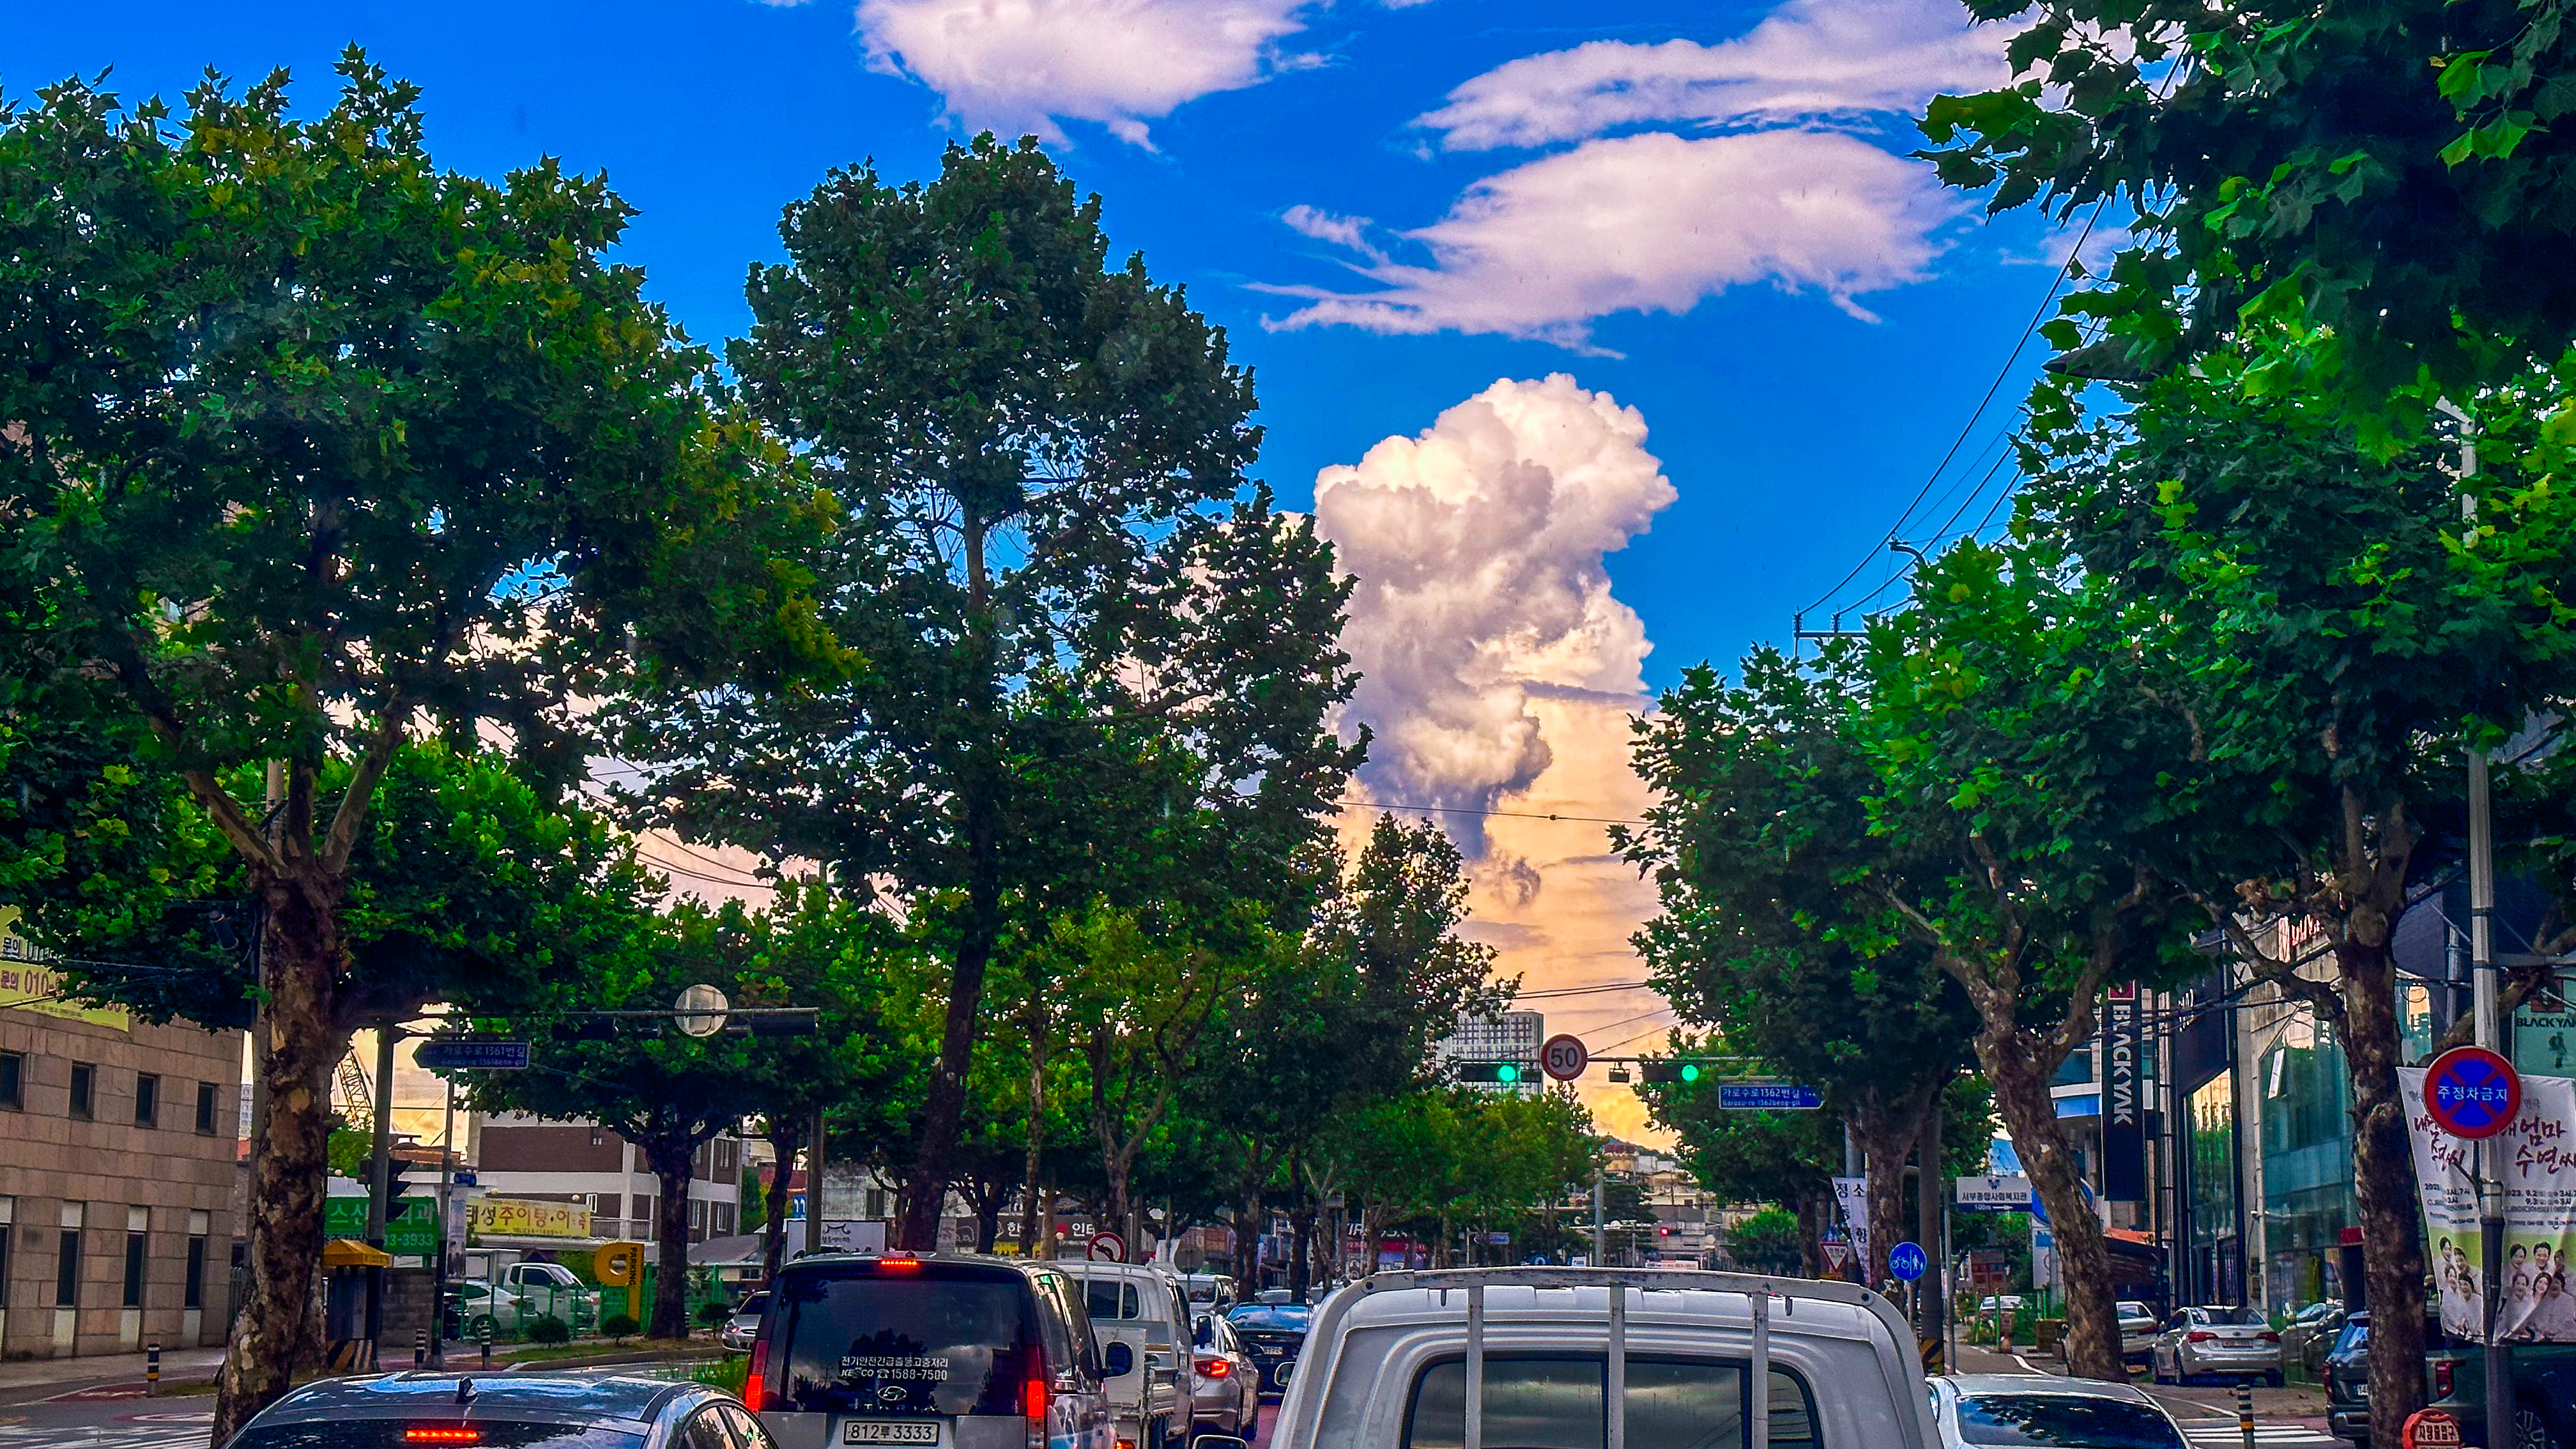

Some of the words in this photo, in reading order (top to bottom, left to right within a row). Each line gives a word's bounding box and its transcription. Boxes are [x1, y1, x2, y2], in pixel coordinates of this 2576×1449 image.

[1, 970, 19, 991] 문의
[1551, 1048, 1578, 1068] 50
[2113, 1004, 2132, 1125] BLACKYAK
[2438, 1085, 2508, 1102] 주정차금지
[1962, 1192, 2027, 1202] 서부종합사회복지관
[629, 1246, 638, 1285] PARKING
[891, 1369, 947, 1381] 1588-7500
[851, 1424, 890, 1439] 812루
[893, 1425, 932, 1440] 3333
